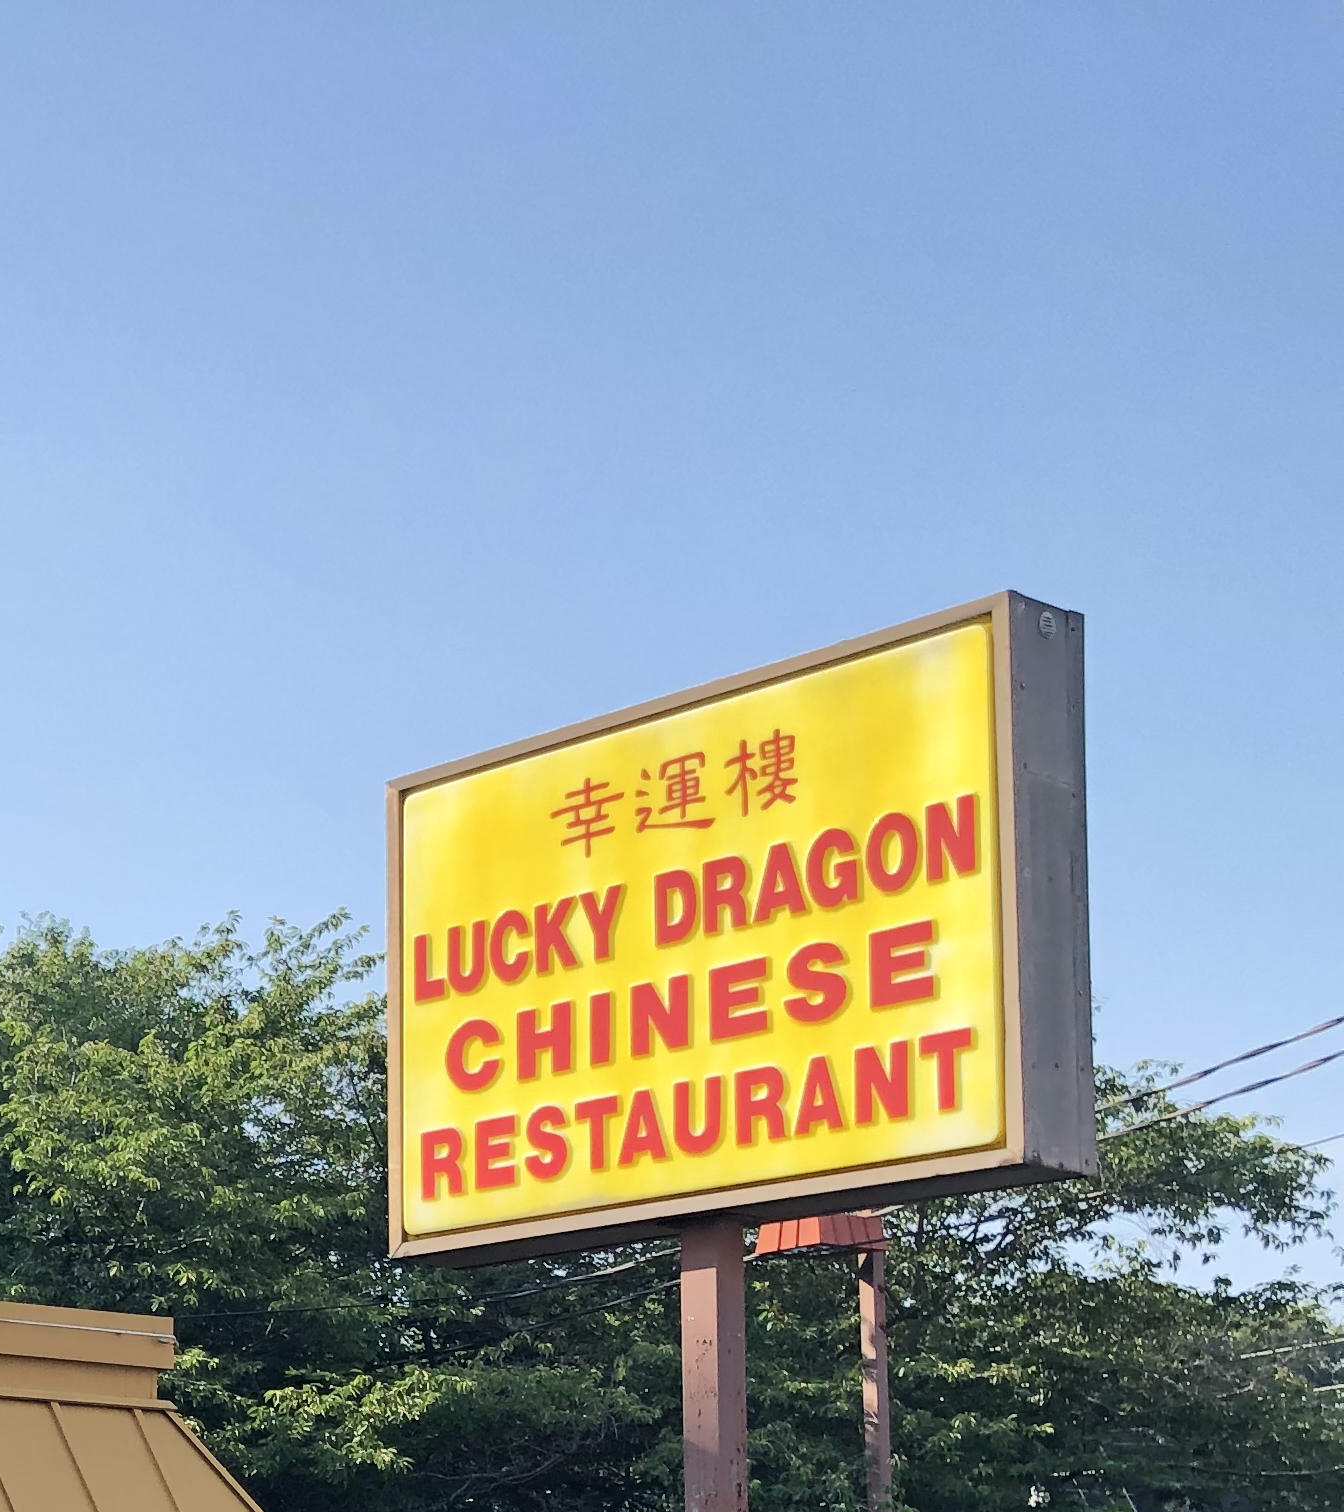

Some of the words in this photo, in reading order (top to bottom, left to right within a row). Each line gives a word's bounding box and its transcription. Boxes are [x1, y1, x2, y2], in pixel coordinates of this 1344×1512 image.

[550, 729, 799, 859] 幸運樓
[413, 884, 626, 1003] LUCKY
[654, 794, 979, 947] DRAGON
[445, 920, 937, 1092] CHINESE
[420, 1027, 975, 1202] RESTAURANT
